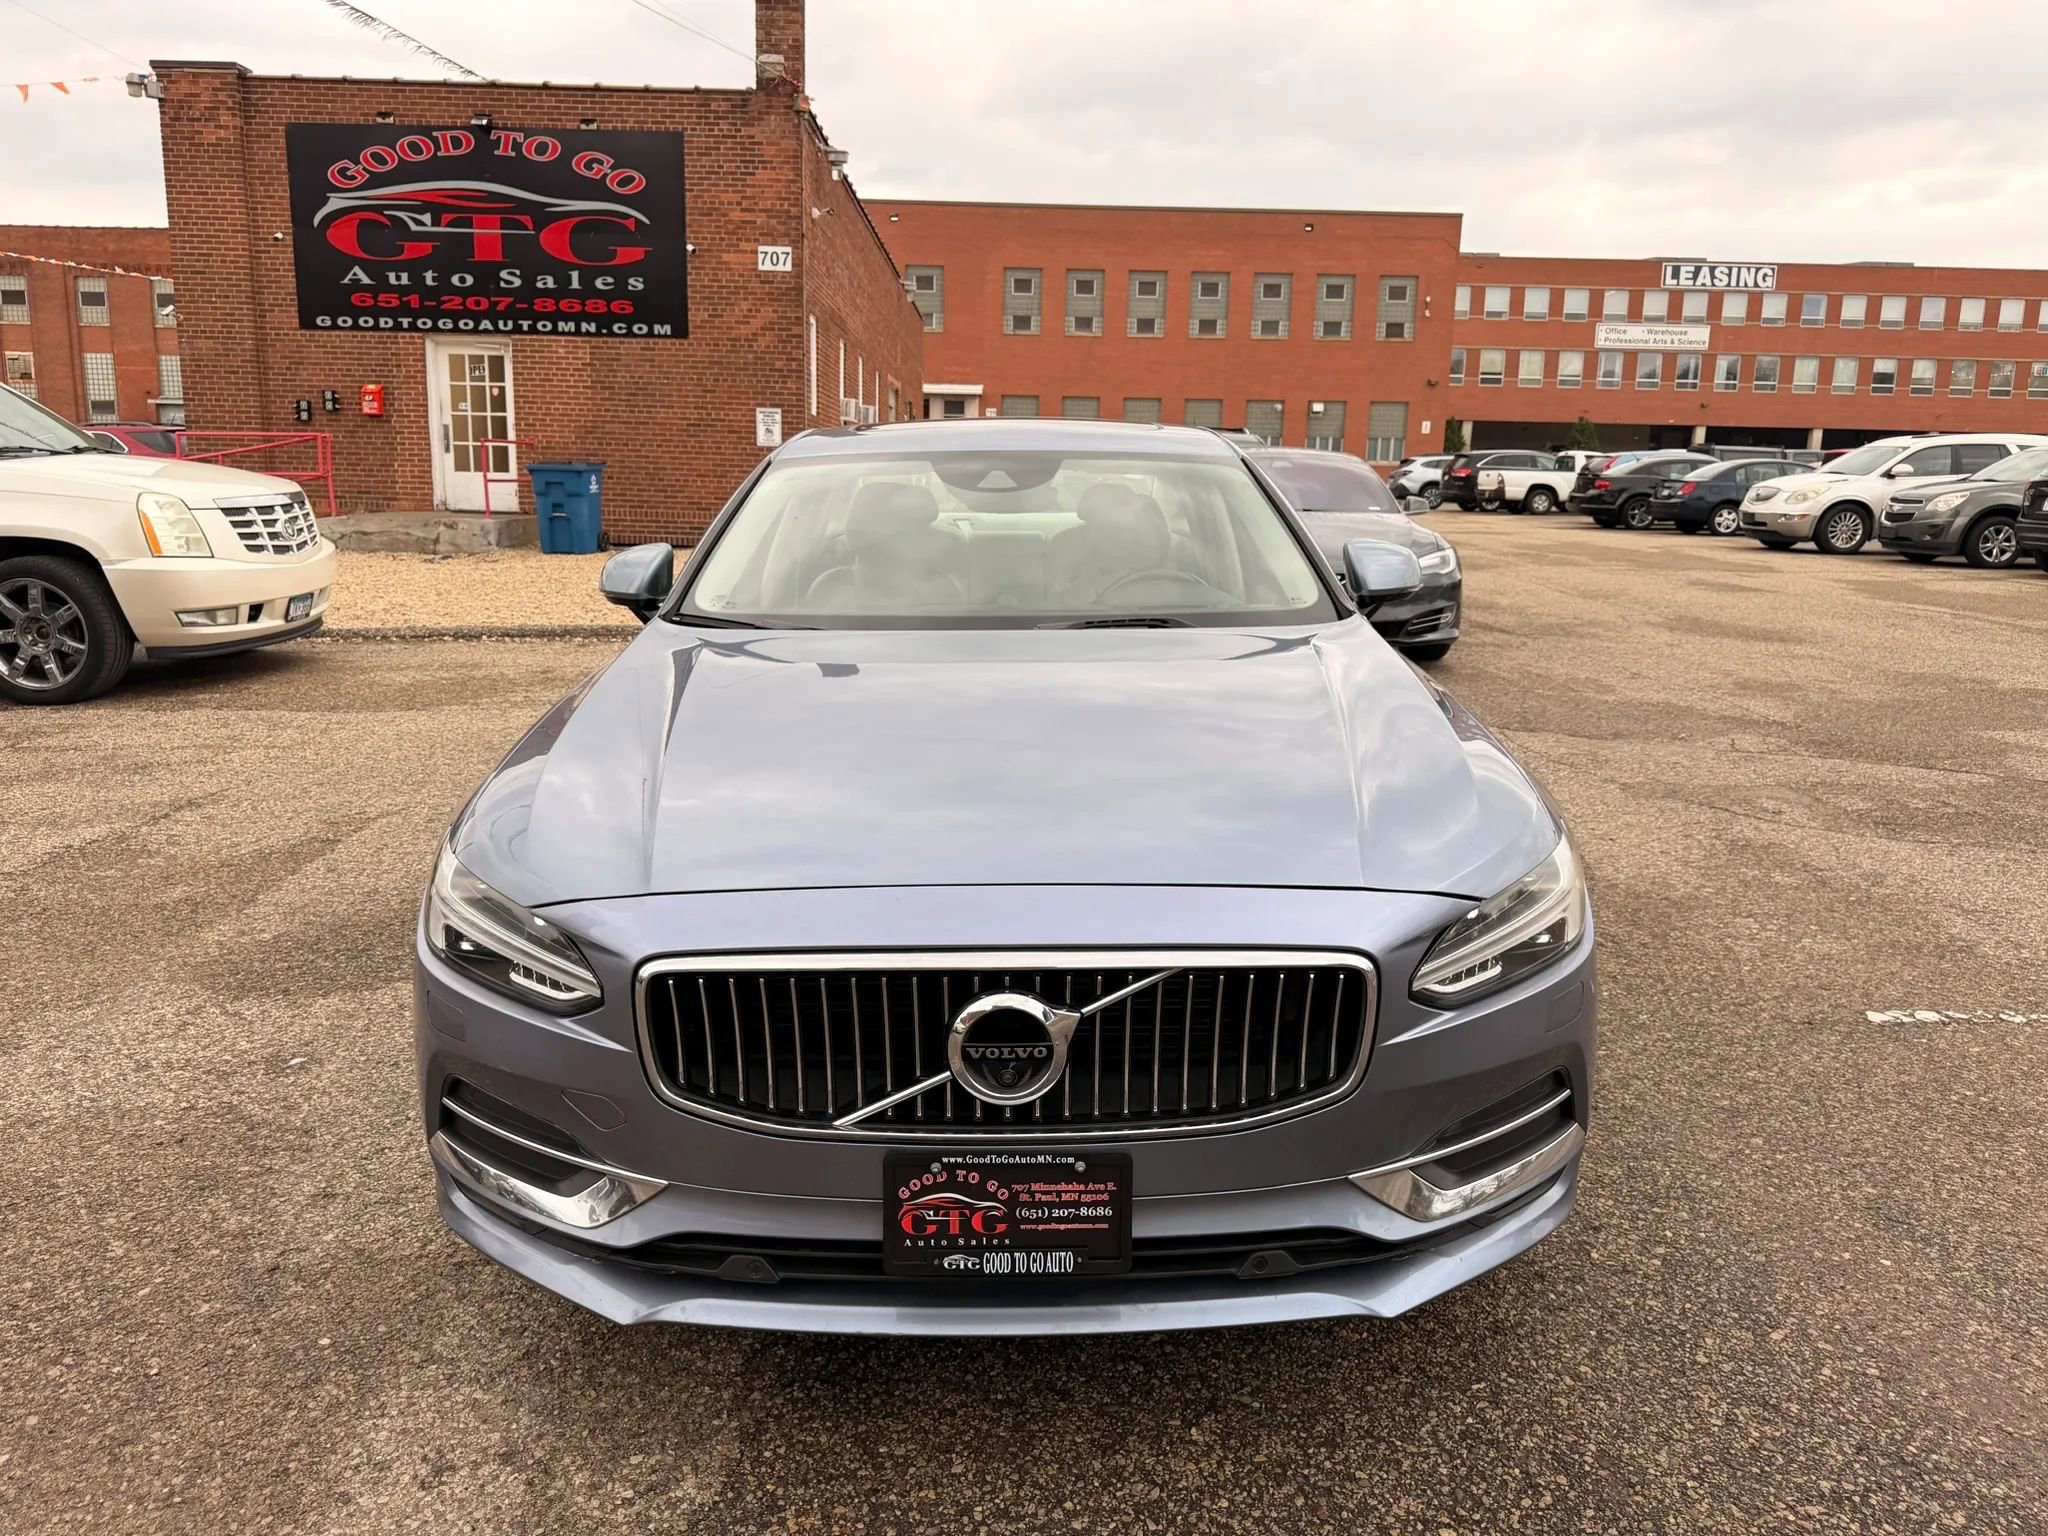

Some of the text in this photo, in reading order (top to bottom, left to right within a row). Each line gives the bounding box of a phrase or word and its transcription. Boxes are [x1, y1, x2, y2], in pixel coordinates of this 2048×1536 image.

[327, 130, 646, 194] GOOD TO GO
[326, 211, 653, 266] GTG
[759, 251, 791, 267] 707
[340, 265, 645, 291] Auto Sales
[1664, 265, 1774, 288] LEASING
[350, 292, 634, 315] 651-207-8686
[315, 315, 672, 336] GOODTOGOAUTOMN.COM
[1604, 327, 1688, 336] Office Warehouse
[1604, 336, 1651, 345] Professional
[966, 1047, 1048, 1059] VOLVO
[941, 1155, 1075, 1164] www.GoodToGoAutoMN.com
[898, 1170, 1009, 1200] GOOD TO GO
[1011, 1184, 1030, 1192] 707
[1086, 1182, 1106, 1191] Ave
[1107, 1182, 1117, 1191] E.
[1019, 1192, 1110, 1203] St. Paul, MN 55106
[1015, 1206, 1113, 1219] (651) 207-8686
[901, 1209, 1009, 1235] GTG
[904, 1237, 1010, 1247] Auto Sales
[943, 1251, 1074, 1274] GTG GOOD TO GO AUTO
